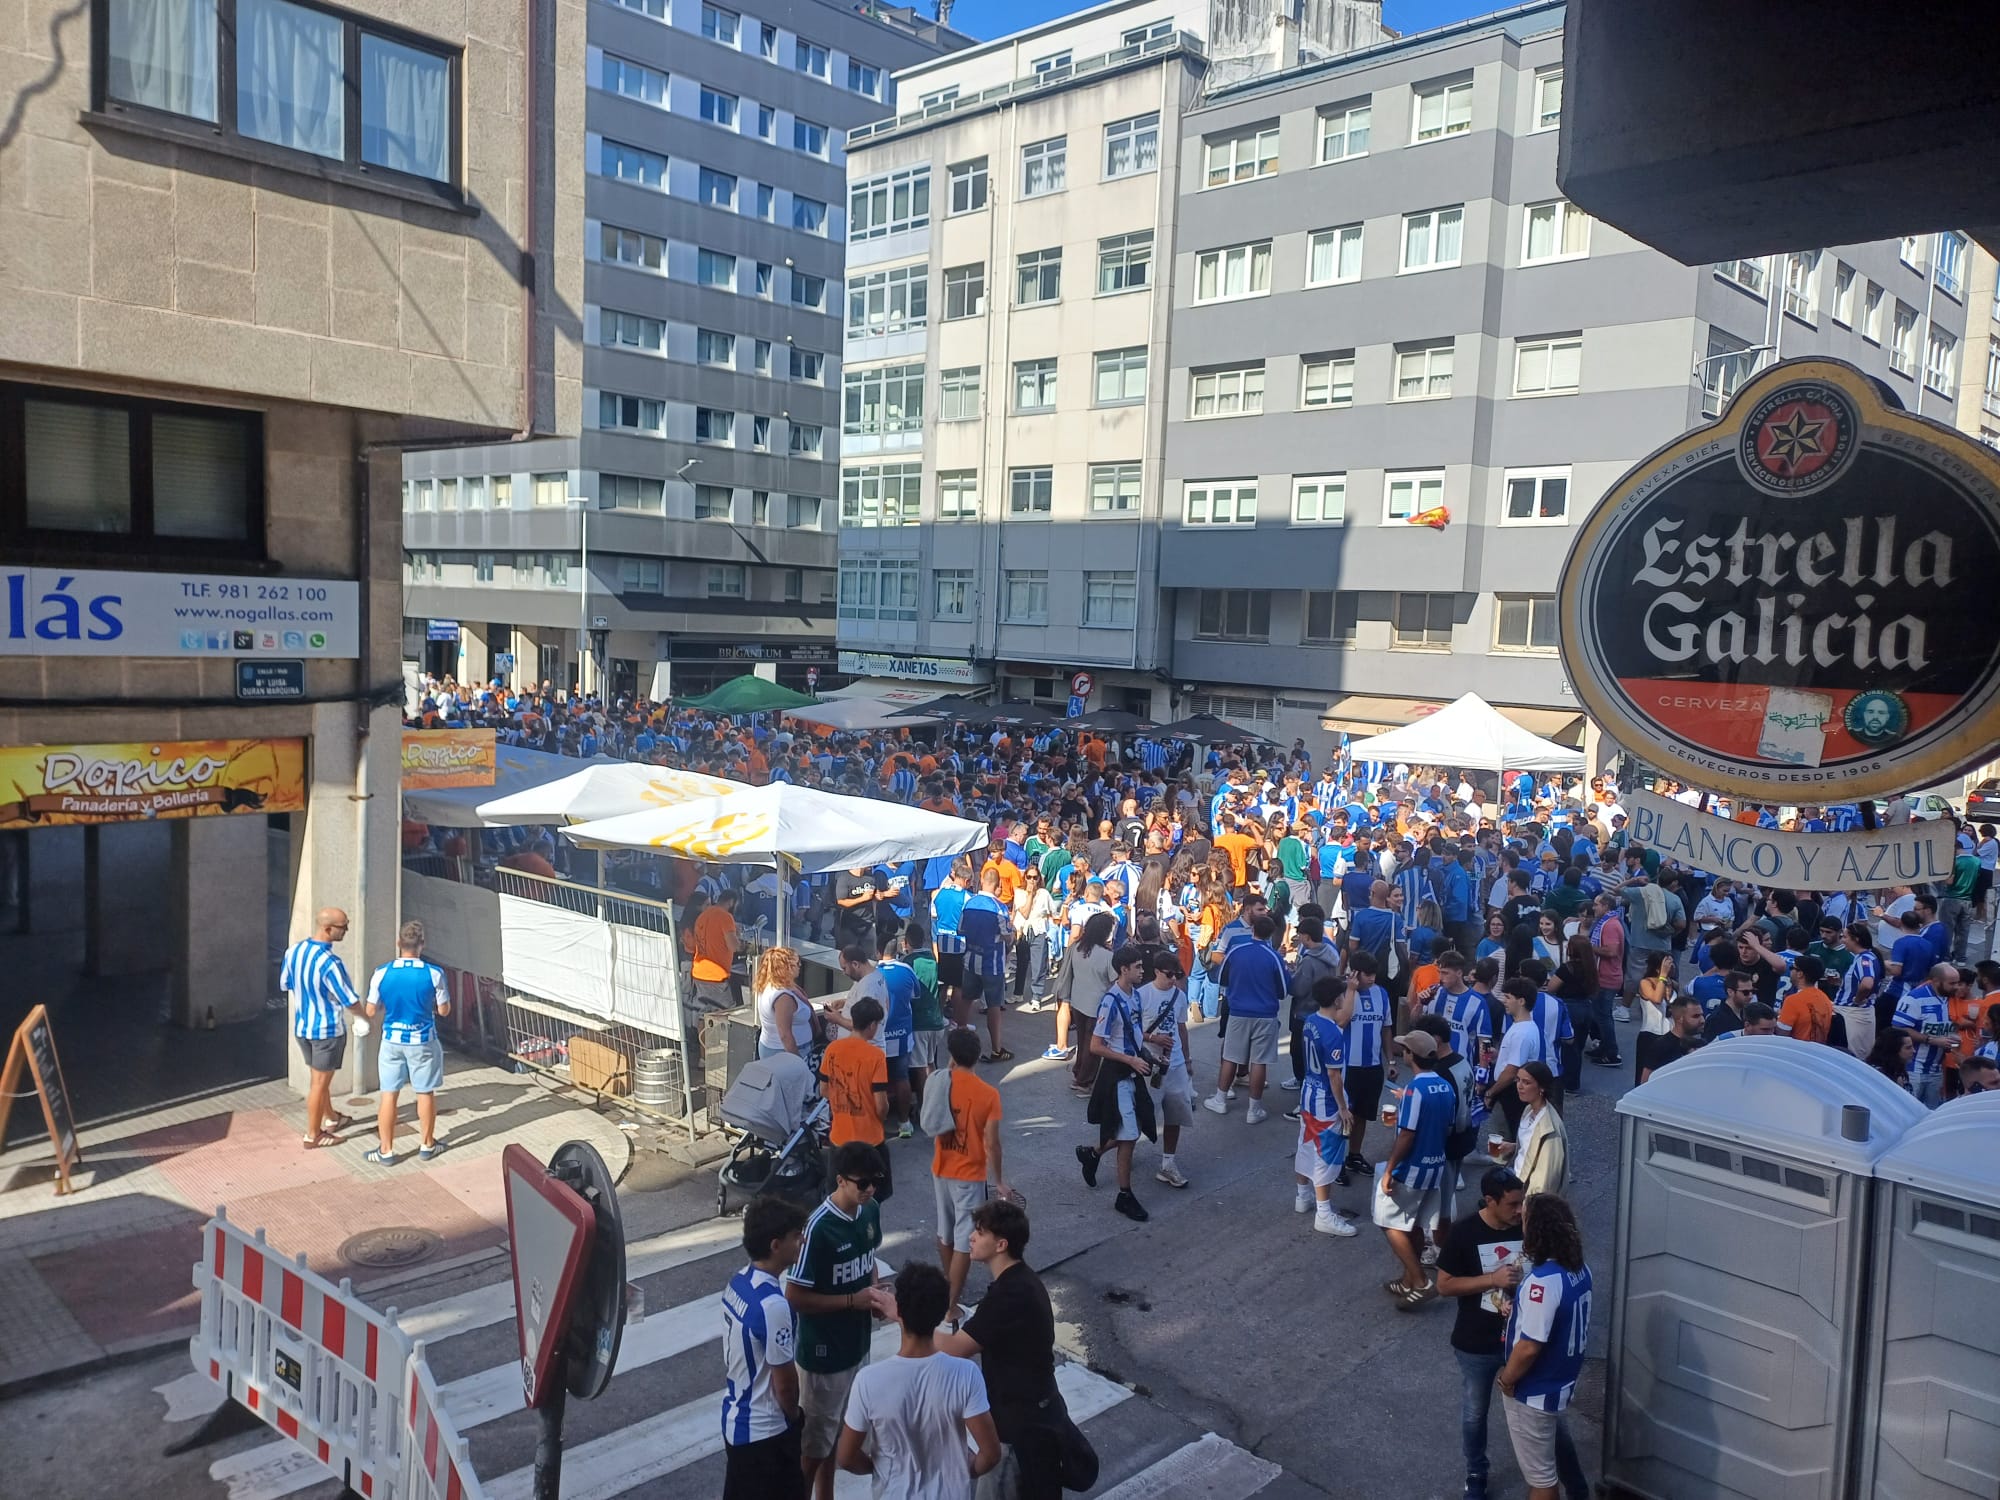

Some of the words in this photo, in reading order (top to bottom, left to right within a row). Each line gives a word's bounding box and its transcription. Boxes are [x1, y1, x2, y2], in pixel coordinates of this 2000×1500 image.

[1752, 391, 1802, 427] ESTRELLA
[1621, 463, 1680, 512] CERVEXA
[1685, 443, 1720, 463] BIER
[1745, 440, 1794, 487] CERVECEROS
[1796, 464, 1831, 486] DESDE
[1631, 514, 1957, 588] Estrella
[7, 574, 123, 641] lás
[181, 582, 211, 597] TLF.
[218, 583, 249, 599] 981
[257, 585, 289, 600] 262
[297, 587, 327, 601] 100
[174, 605, 333, 623] www.nogallas.com
[1643, 591, 1930, 672] Galicia
[889, 660, 938, 676] XANETAS
[1658, 696, 1764, 713] CERVEZA
[44, 746, 227, 795] Dopico
[1668, 745, 1770, 780] CERVECEROS
[1779, 771, 1836, 782] DESDE
[1842, 762, 1882, 778] 1906
[61, 797, 138, 812] Panadería
[152, 791, 209, 809] Bollería
[1633, 806, 1783, 877] BLANCO
[1796, 846, 1820, 882] Y
[1837, 840, 1949, 882] AZUL
